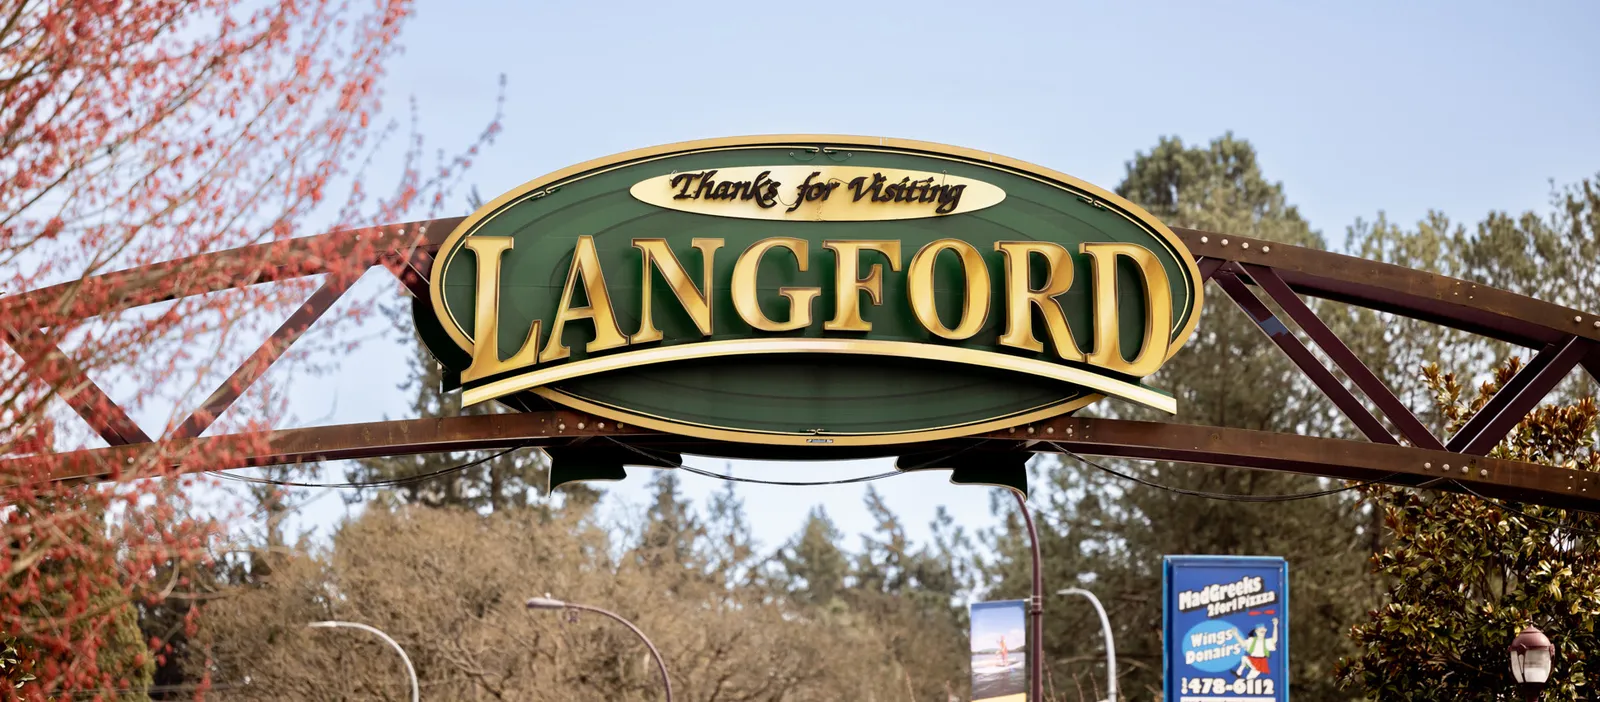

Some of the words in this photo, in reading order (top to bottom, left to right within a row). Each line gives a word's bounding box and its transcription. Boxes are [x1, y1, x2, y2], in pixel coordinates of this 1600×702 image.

[669, 170, 782, 209] Thanks
[785, 171, 840, 213] for
[846, 171, 968, 214] Visiting
[460, 234, 1174, 384] LANGFORD
[1179, 576, 1262, 611] MadGreeks
[1190, 628, 1234, 648] Wings
[1185, 643, 1242, 665] Donairs
[1188, 677, 1275, 695] 478-6112
